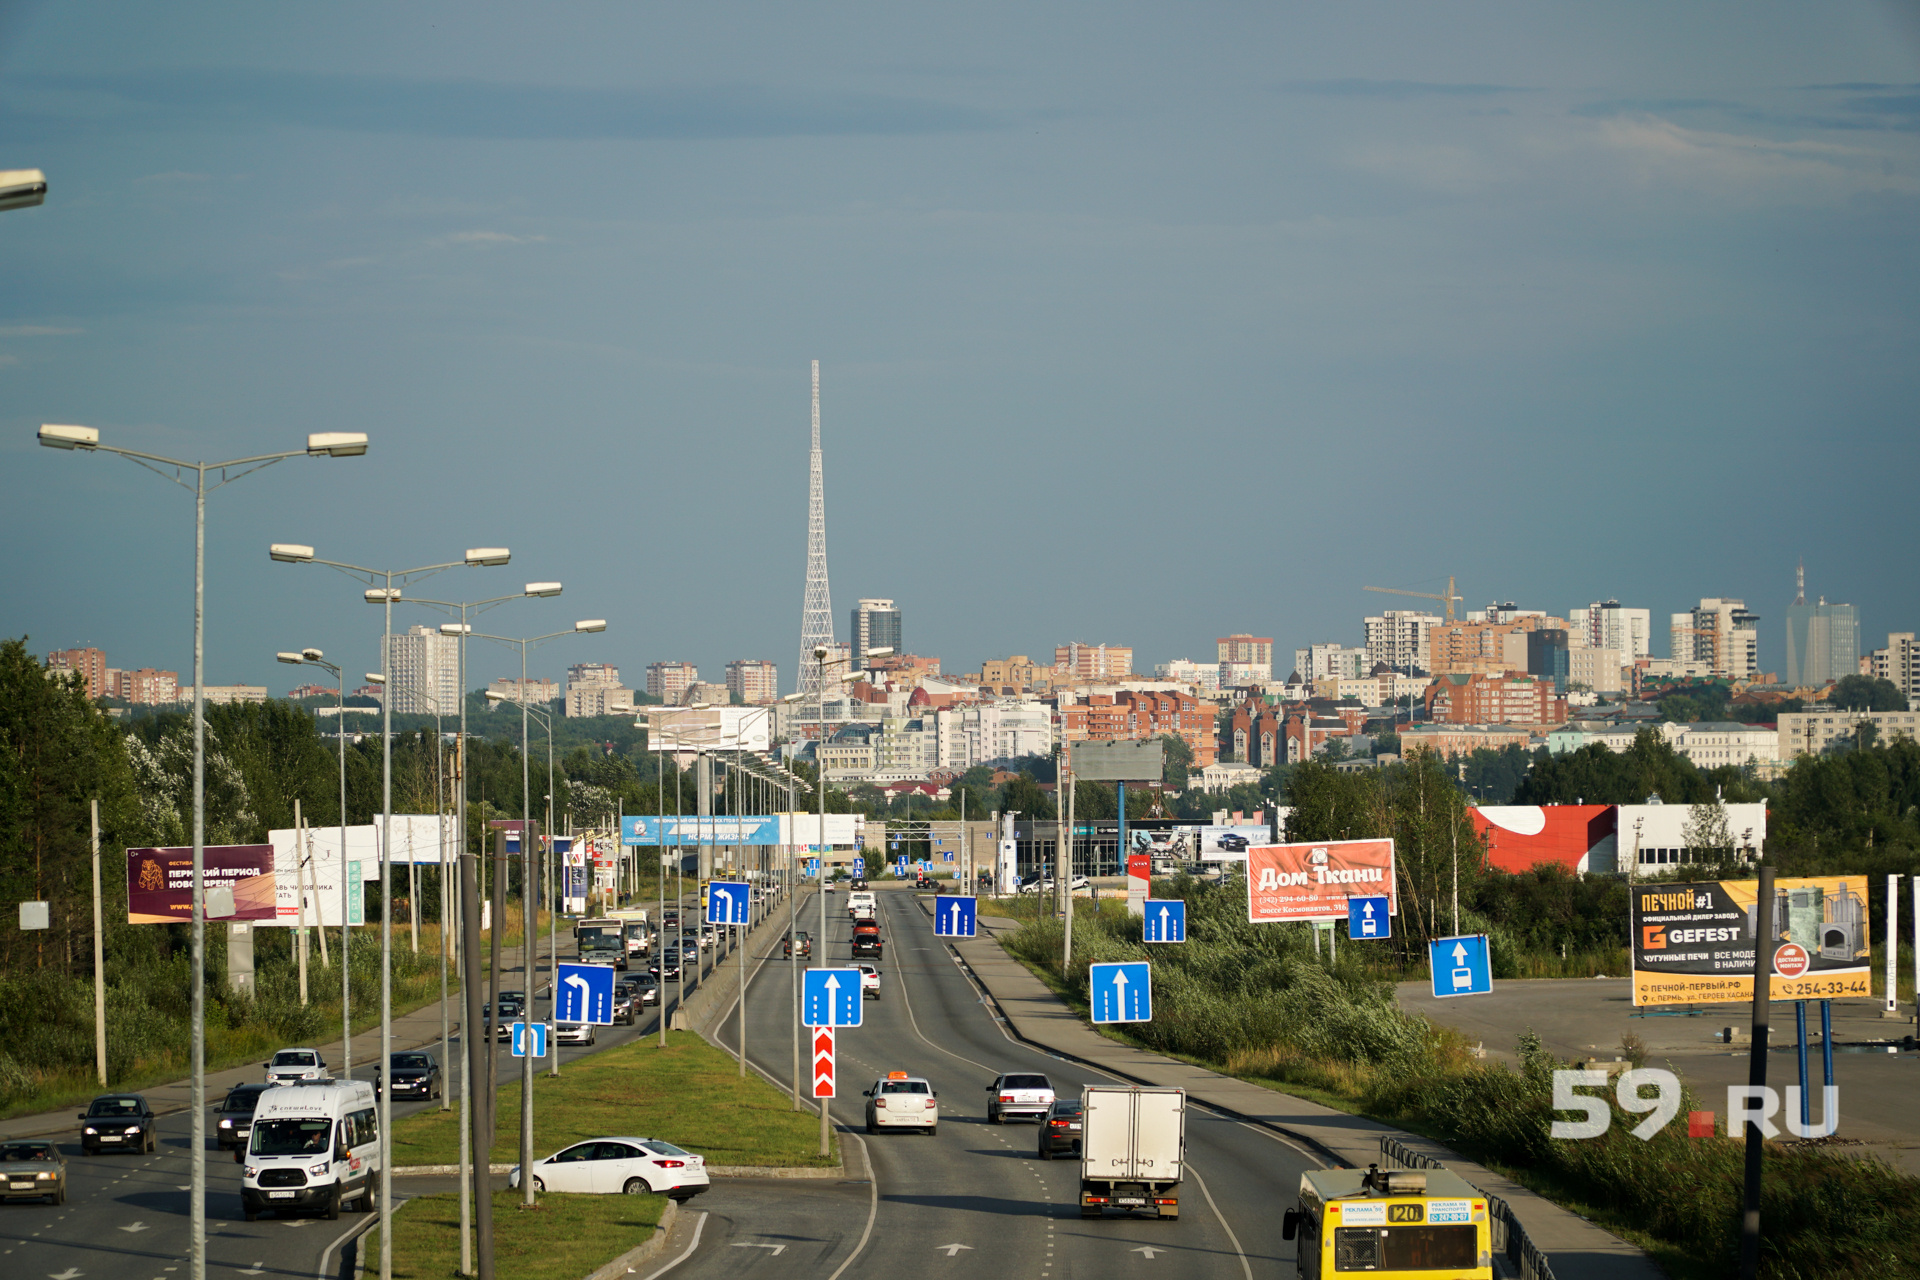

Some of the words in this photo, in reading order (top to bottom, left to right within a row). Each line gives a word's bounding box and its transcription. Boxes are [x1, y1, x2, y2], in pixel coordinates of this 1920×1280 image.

[168, 867, 220, 878] ПЕРМКИЙ
[221, 867, 260, 877] ПЕРИОД
[1258, 868, 1308, 891] Дом
[1313, 865, 1384, 885] Ткани
[203, 879, 235, 887] ВРЕМЯ
[1259, 896, 1278, 905] (342)
[1280, 894, 1319, 903] 294-60-80
[1642, 889, 1695, 912] ПЕЧНОЙ
[1695, 892, 1714, 910] #1
[1282, 904, 1333, 914] Космонавтов,
[1642, 914, 1692, 923] ОФИЦИАЛЬНЫЙ
[1692, 913, 1713, 921] ДИЛЕР
[1714, 912, 1740, 920] ЗАВОДА
[1669, 927, 1741, 944] GEFEST
[1644, 953, 1686, 963] ЧУГУННЫЕ
[1687, 952, 1709, 961] ПЕЧИ
[1714, 951, 1731, 960] ВСЕ
[1714, 961, 1721, 969] В
[1651, 981, 1741, 992] ПЕЧНОЙ-ПЕРВЫЙ.РФ
[1796, 981, 1867, 995] 254-33-44
[1698, 991, 1725, 1000] ГЕРОЕВ
